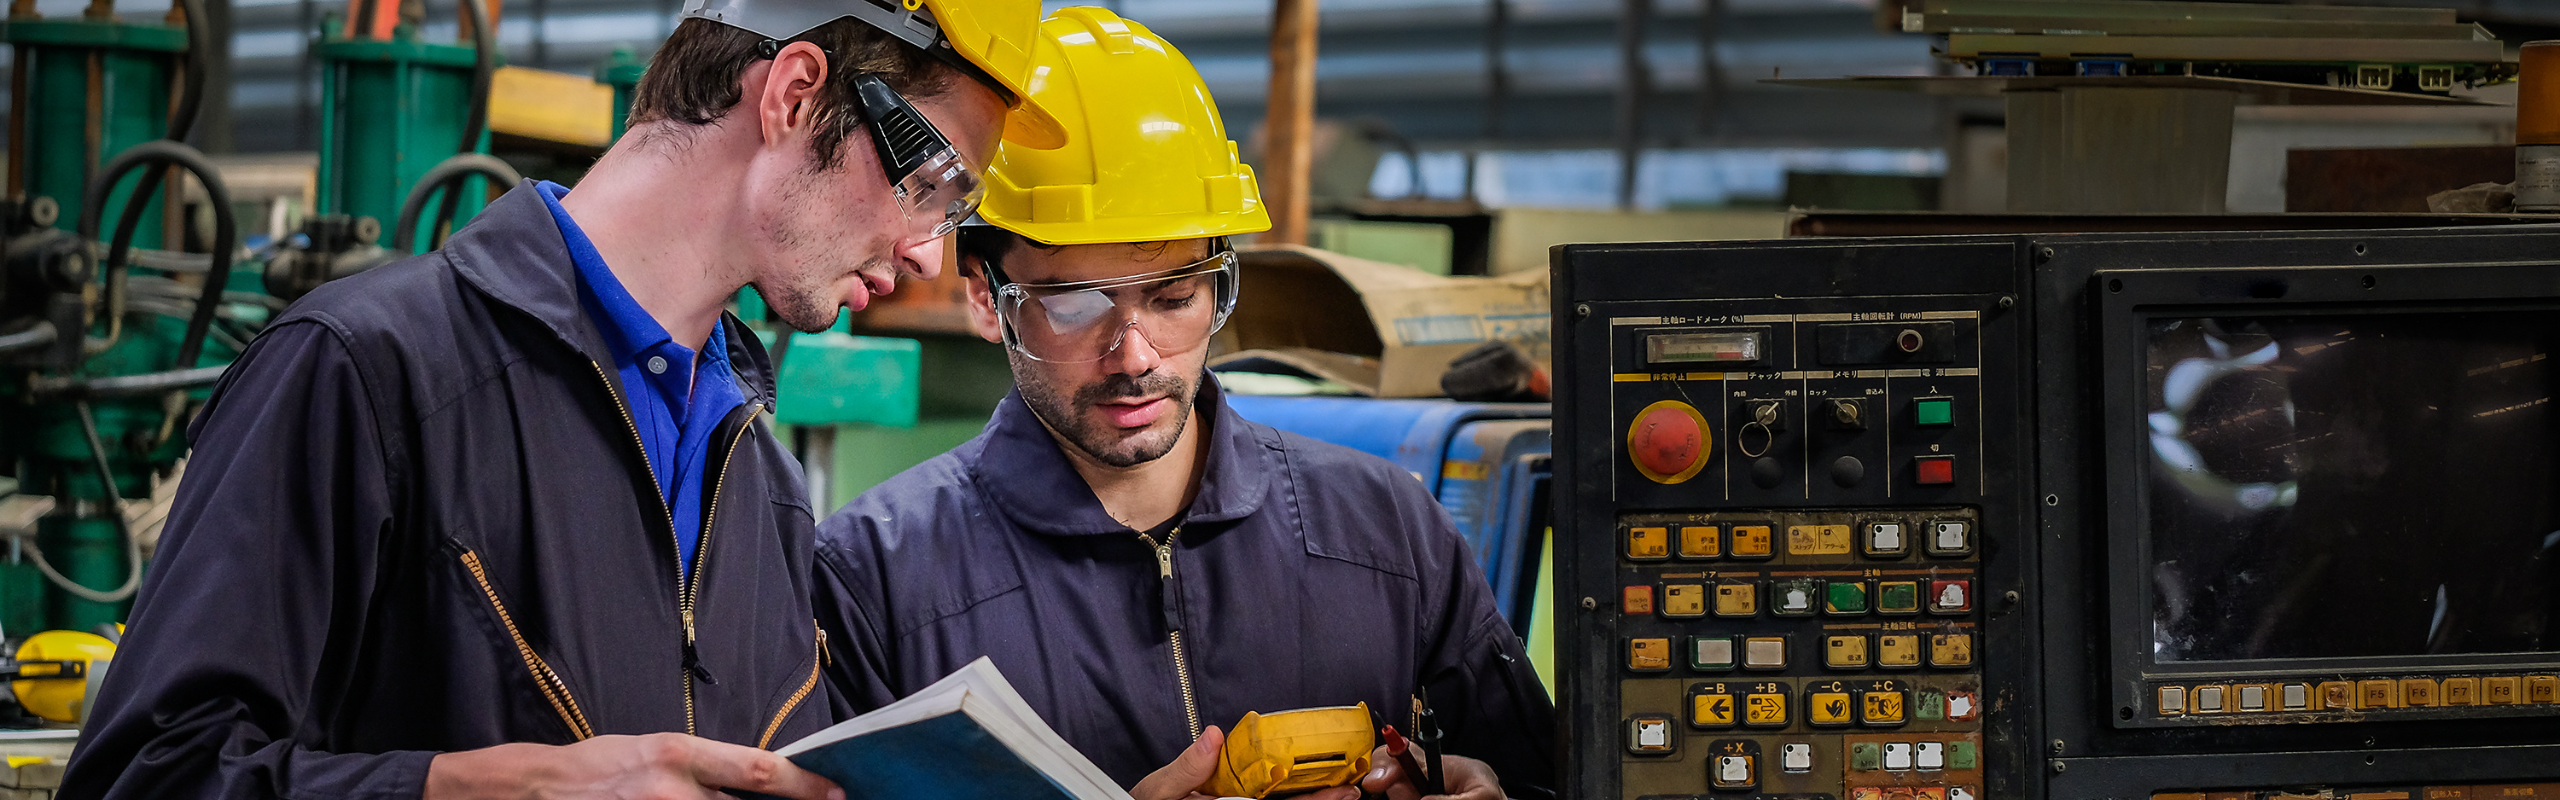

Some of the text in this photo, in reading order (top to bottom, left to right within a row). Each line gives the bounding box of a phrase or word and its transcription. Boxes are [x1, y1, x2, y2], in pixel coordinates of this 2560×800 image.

[1899, 311, 1922, 321] (RPM)
[1748, 371, 1782, 380] チャック
[1834, 370, 1858, 379] メモリ
[1809, 389, 1828, 397] ロック
[1929, 385, 1939, 394] 入
[1929, 443, 1940, 452] 切
[1702, 571, 1717, 579] ドア
[2370, 690, 2385, 699] F5
[2412, 688, 2427, 698] F6
[2453, 686, 2468, 696] F7
[2494, 685, 2510, 696] F8
[2536, 685, 2551, 695] F9
